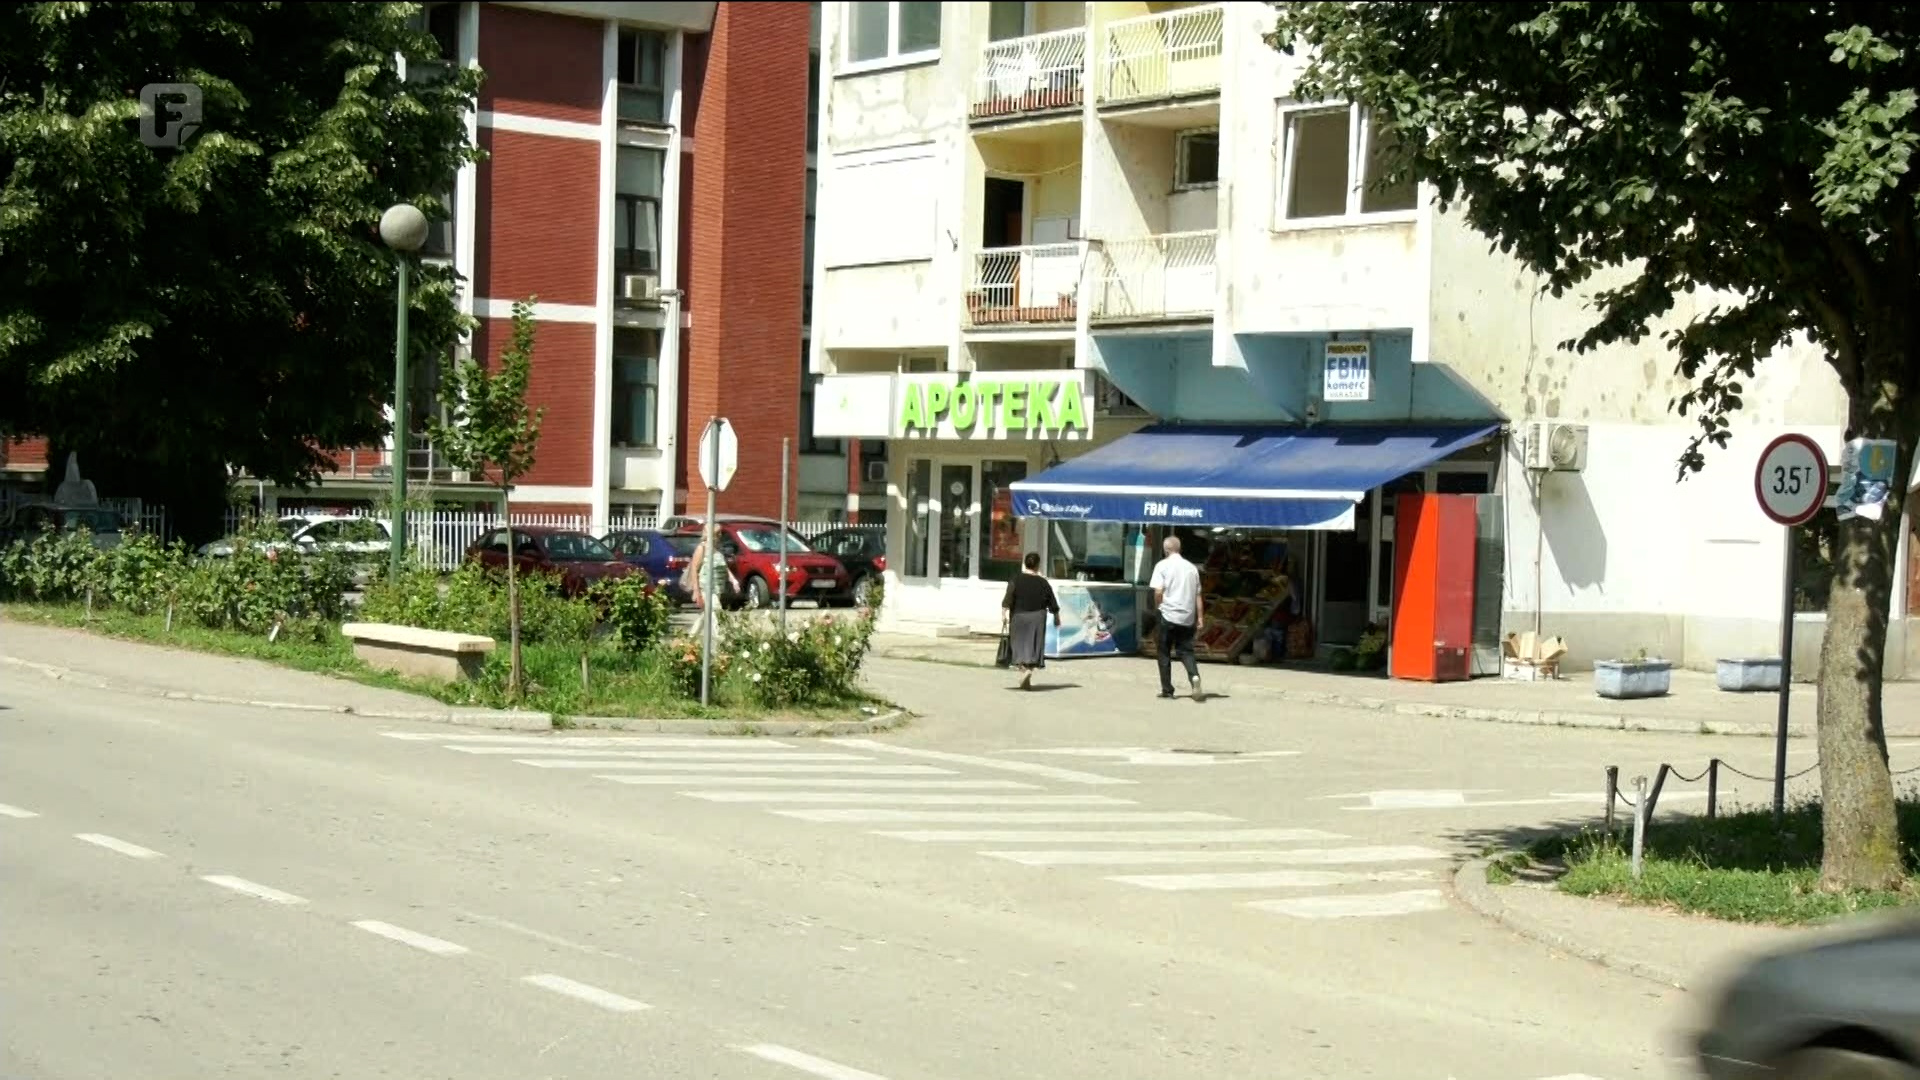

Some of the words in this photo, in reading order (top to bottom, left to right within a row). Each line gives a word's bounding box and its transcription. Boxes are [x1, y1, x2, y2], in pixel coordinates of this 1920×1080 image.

[1327, 355, 1366, 379] FBM
[900, 379, 1086, 431] APOTEKA
[1773, 466, 1801, 494] 3.5
[1804, 467, 1813, 483] T
[1144, 501, 1168, 516] FBM
